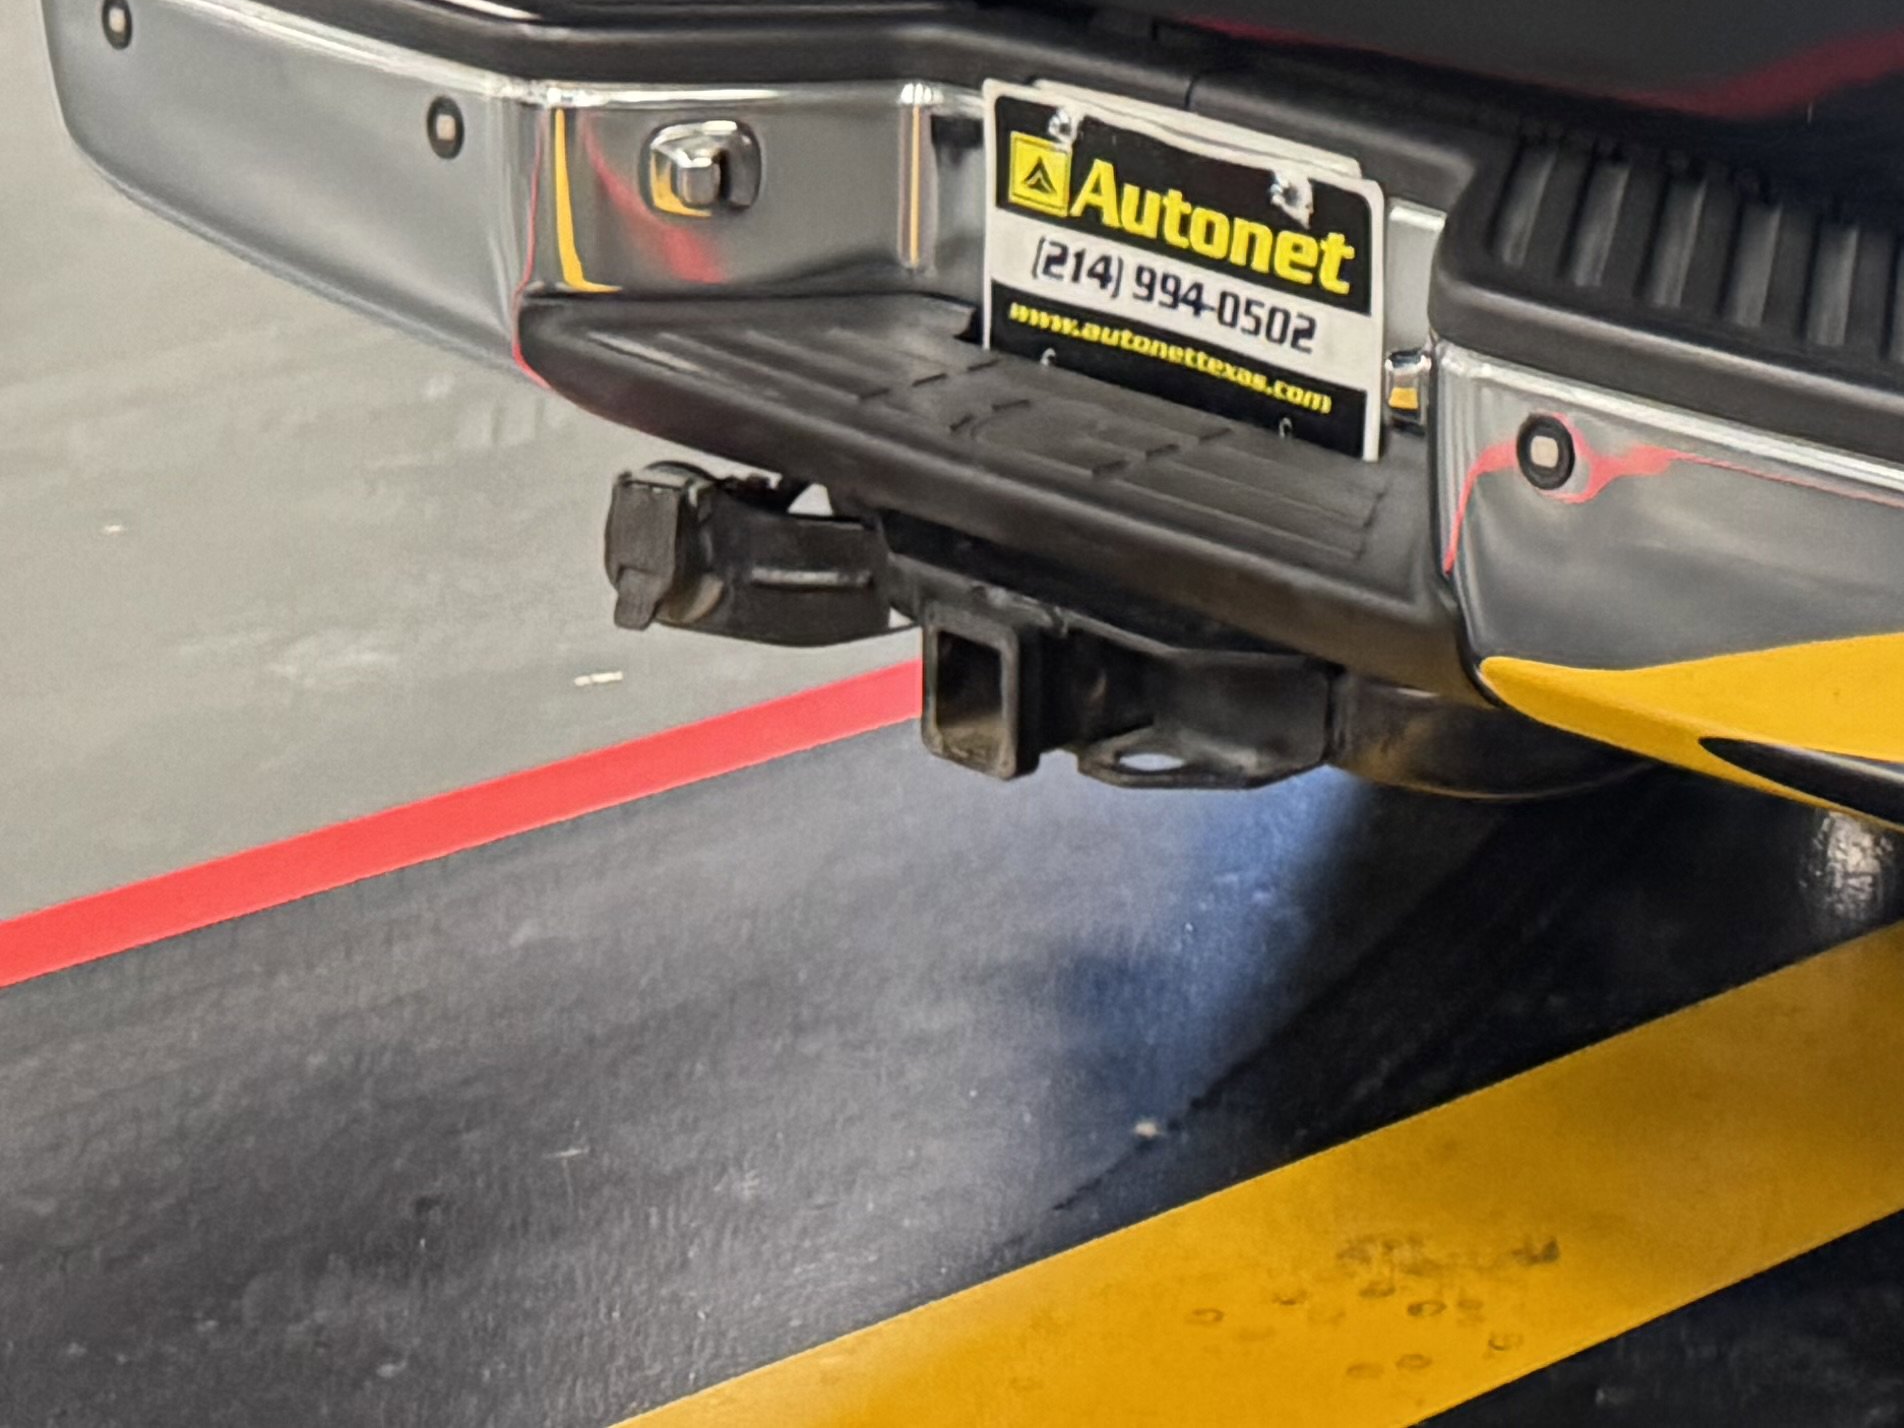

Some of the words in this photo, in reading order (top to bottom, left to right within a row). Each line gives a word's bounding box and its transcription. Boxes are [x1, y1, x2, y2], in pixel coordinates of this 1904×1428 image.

[1068, 157, 1356, 296] Autonet
[1031, 234, 1124, 299] (214)
[1132, 263, 1318, 354] 994-0502
[1008, 300, 1333, 415] www.autonettexas.com
